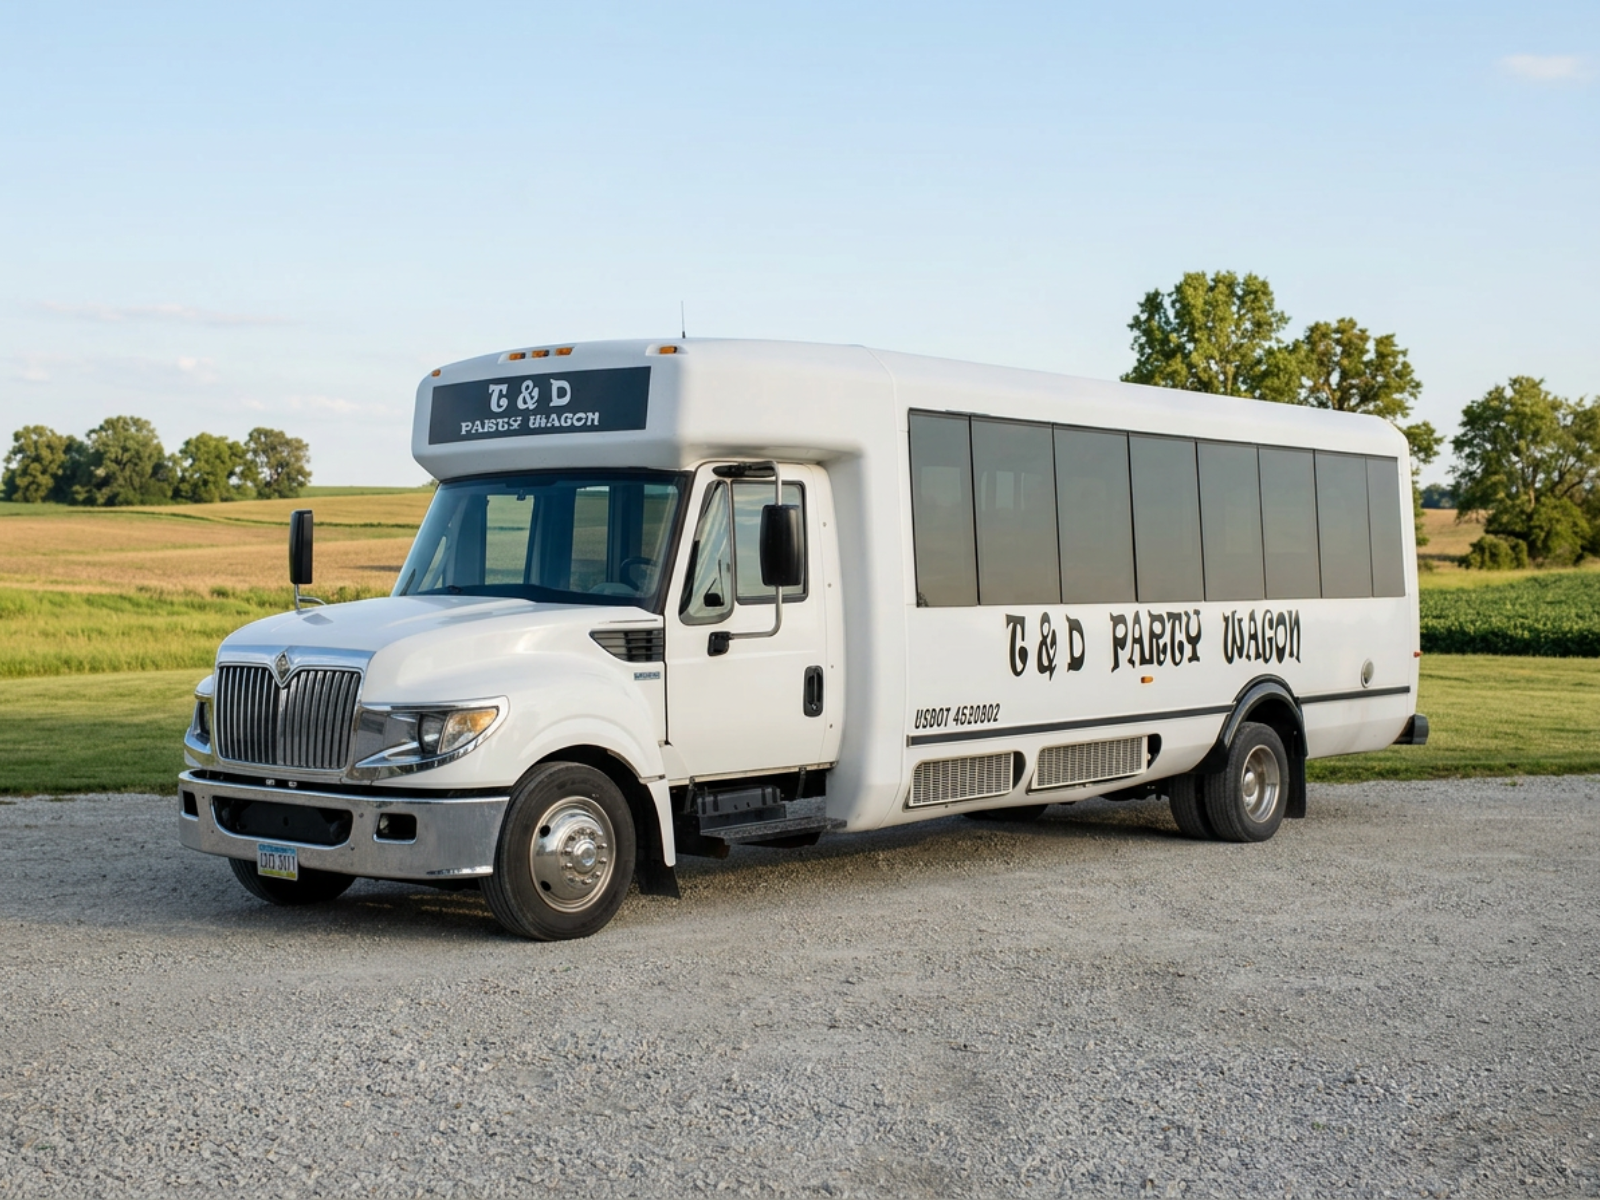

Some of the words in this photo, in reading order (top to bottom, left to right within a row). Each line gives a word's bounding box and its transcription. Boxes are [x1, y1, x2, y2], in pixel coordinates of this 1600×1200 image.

[516, 379, 539, 410] &
[549, 378, 571, 407] D
[1036, 611, 1057, 681] &
[1065, 613, 1086, 673] D
[1109, 608, 1202, 673] PARTY
[1222, 609, 1301, 665] WAGON
